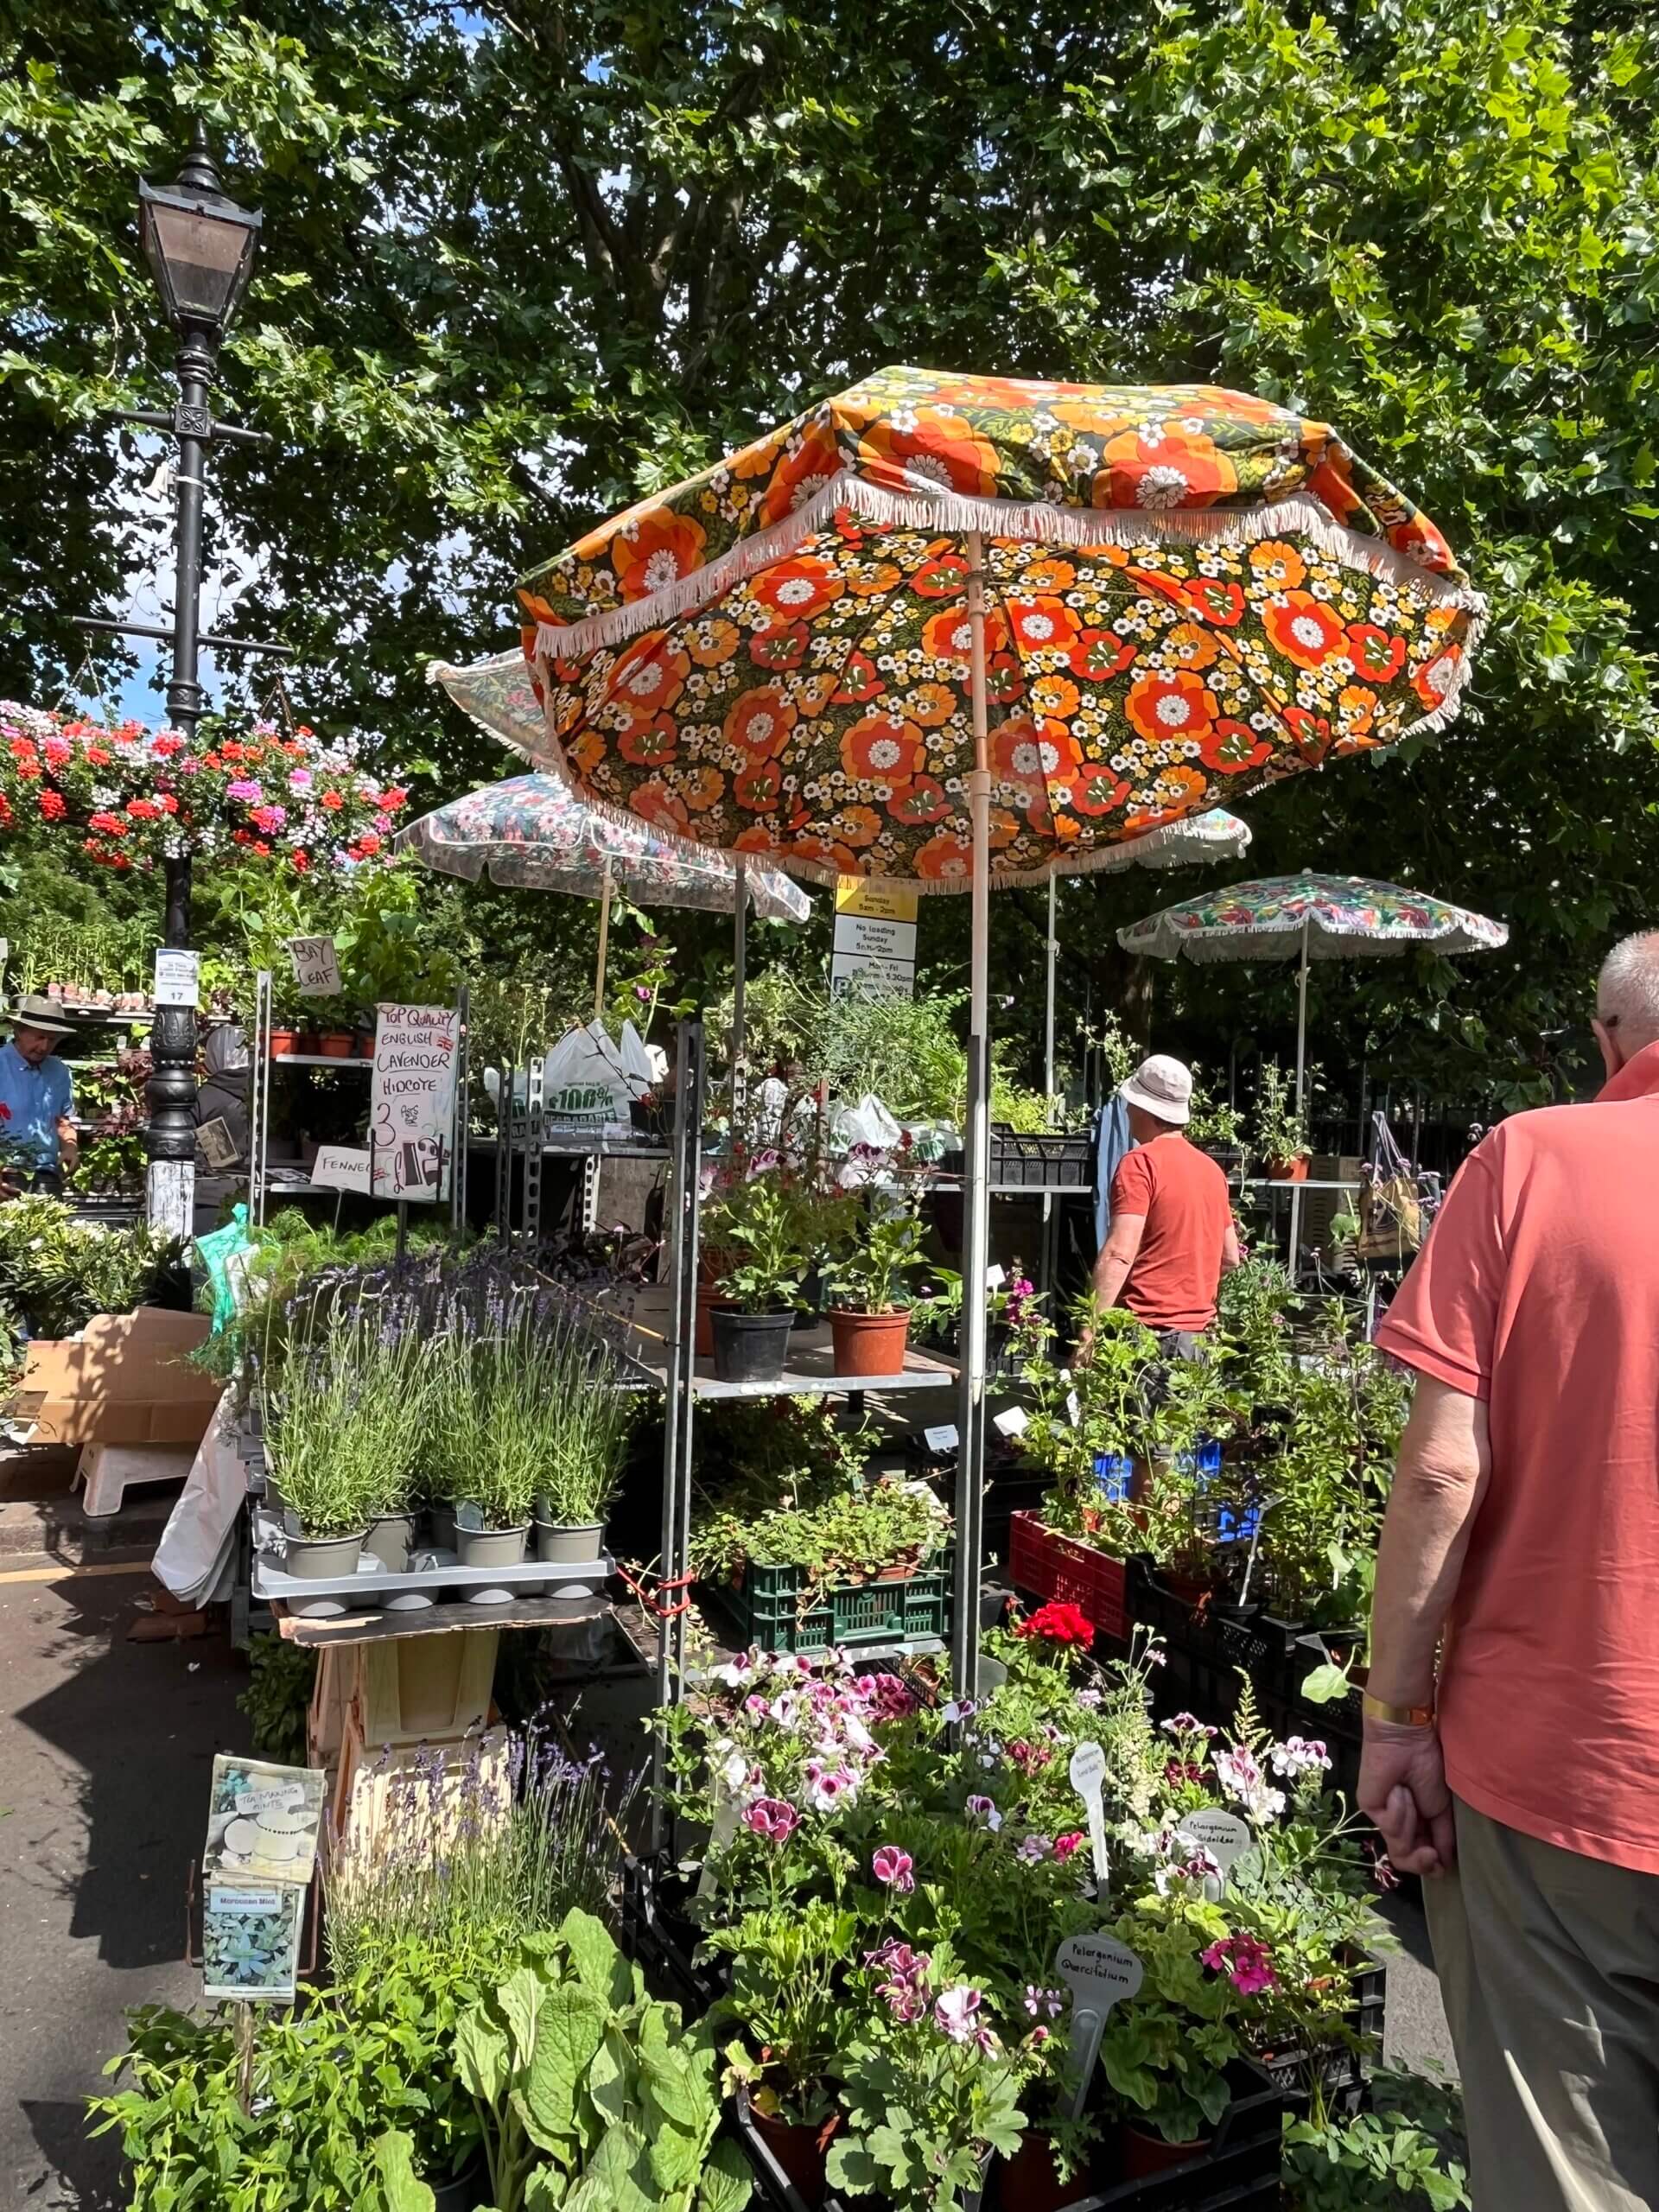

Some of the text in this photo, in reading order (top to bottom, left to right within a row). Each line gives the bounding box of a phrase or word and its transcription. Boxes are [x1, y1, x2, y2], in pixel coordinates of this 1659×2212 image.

[862, 934, 888, 944] Sunday
[868, 925, 896, 936] loading
[294, 940, 327, 965] BAY
[298, 967, 334, 987] LEAF
[171, 992, 183, 1001] 17
[379, 1007, 457, 1037] TOP QUALITY
[381, 1031, 432, 1046] ENGLISH
[377, 1052, 449, 1072] LAVENDER
[374, 1103, 396, 1147] 3
[1189, 1821, 1237, 1834] Pelargonium
[1072, 1942, 1133, 1967] Pelargonium
